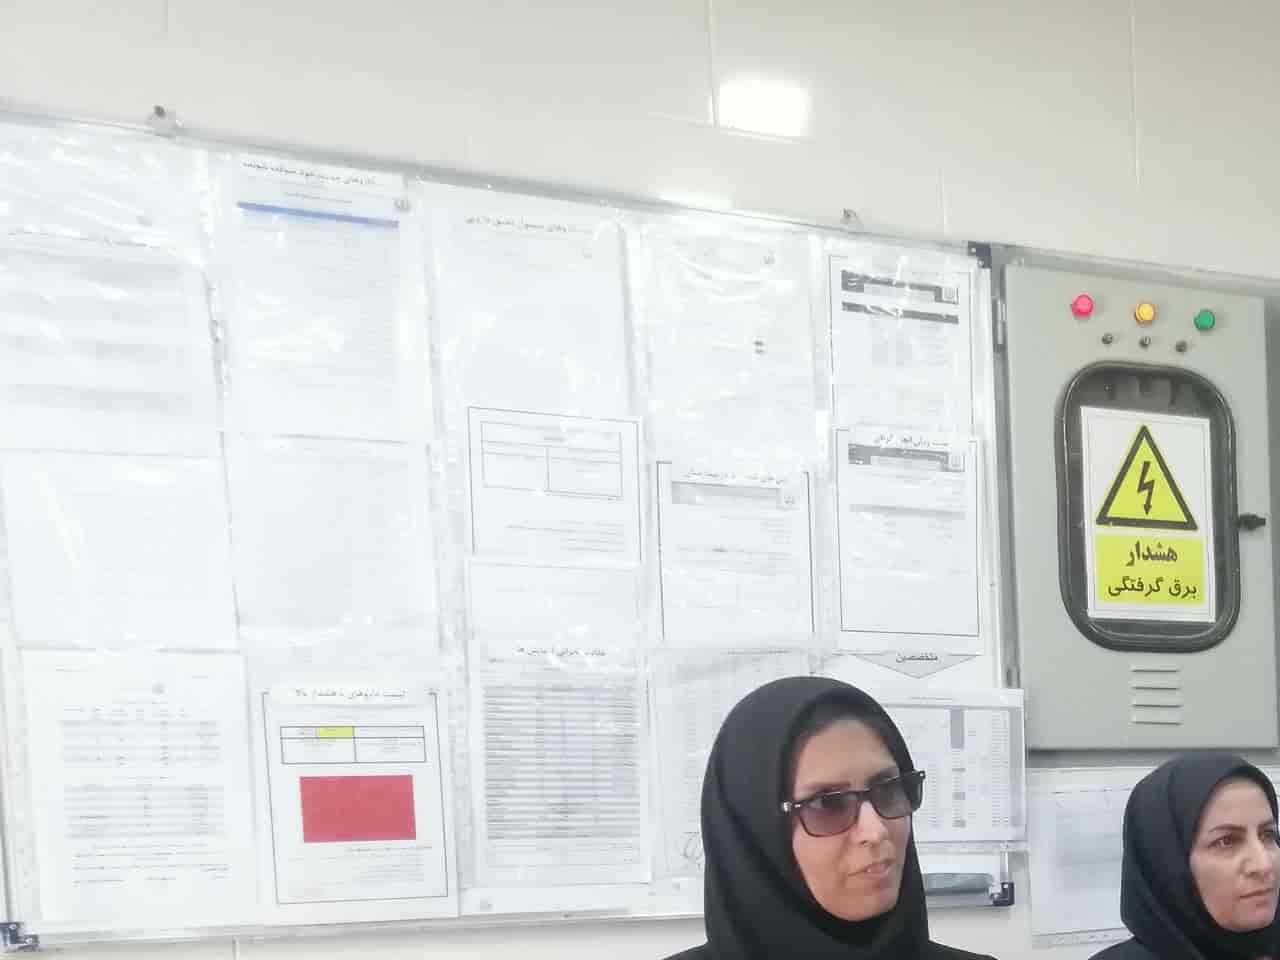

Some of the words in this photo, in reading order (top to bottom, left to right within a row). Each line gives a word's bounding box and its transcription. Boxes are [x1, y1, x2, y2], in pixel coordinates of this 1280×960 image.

[1125, 540, 1178, 567] هشدار
[1107, 575, 1164, 597] گرفتگی
[1168, 579, 1198, 600] برق
